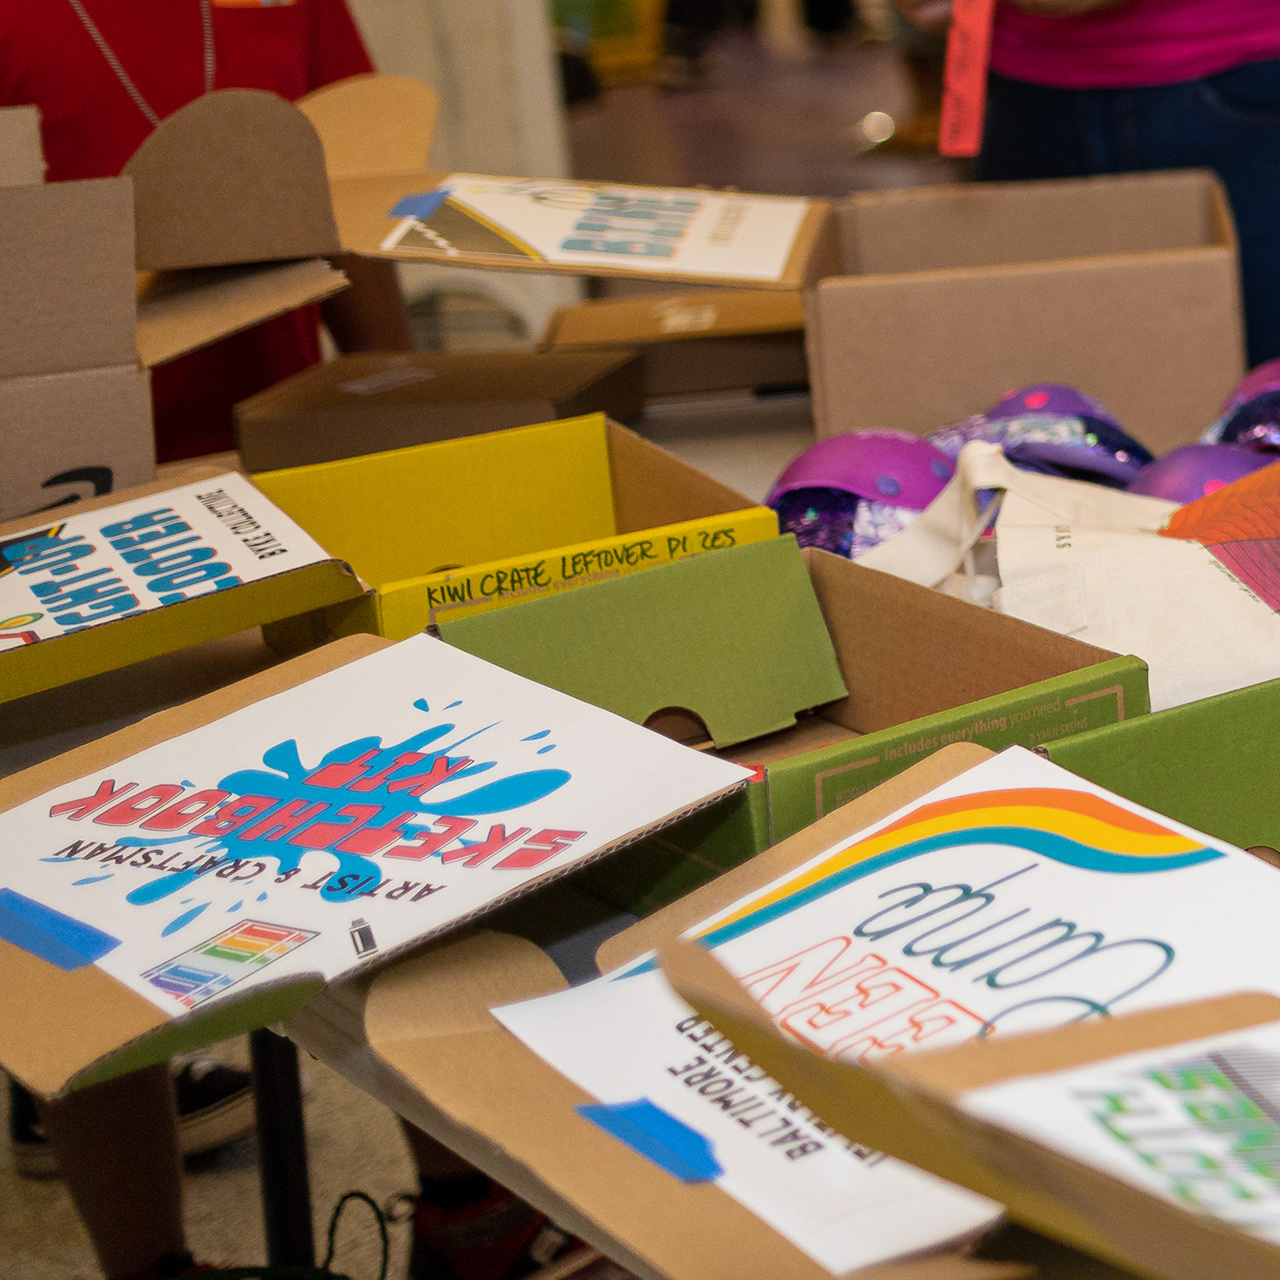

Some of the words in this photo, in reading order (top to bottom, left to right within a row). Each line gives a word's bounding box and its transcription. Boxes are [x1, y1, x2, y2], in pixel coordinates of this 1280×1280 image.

[426, 577, 473, 609] KIWI
[479, 559, 553, 598] CRATE
[561, 539, 657, 582] LEFTOVER
[884, 735, 939, 762] Includes
[940, 716, 1008, 746] everything
[1009, 707, 1032, 728] you
[1032, 698, 1061, 718] need
[300, 746, 473, 798] KIT
[46, 778, 588, 872] SKETCHBOOK
[51, 836, 268, 883] CRAFTSMAN
[272, 866, 303, 886] &
[308, 870, 447, 906] ARTIST
[666, 1055, 825, 1162] BALTIMORE
